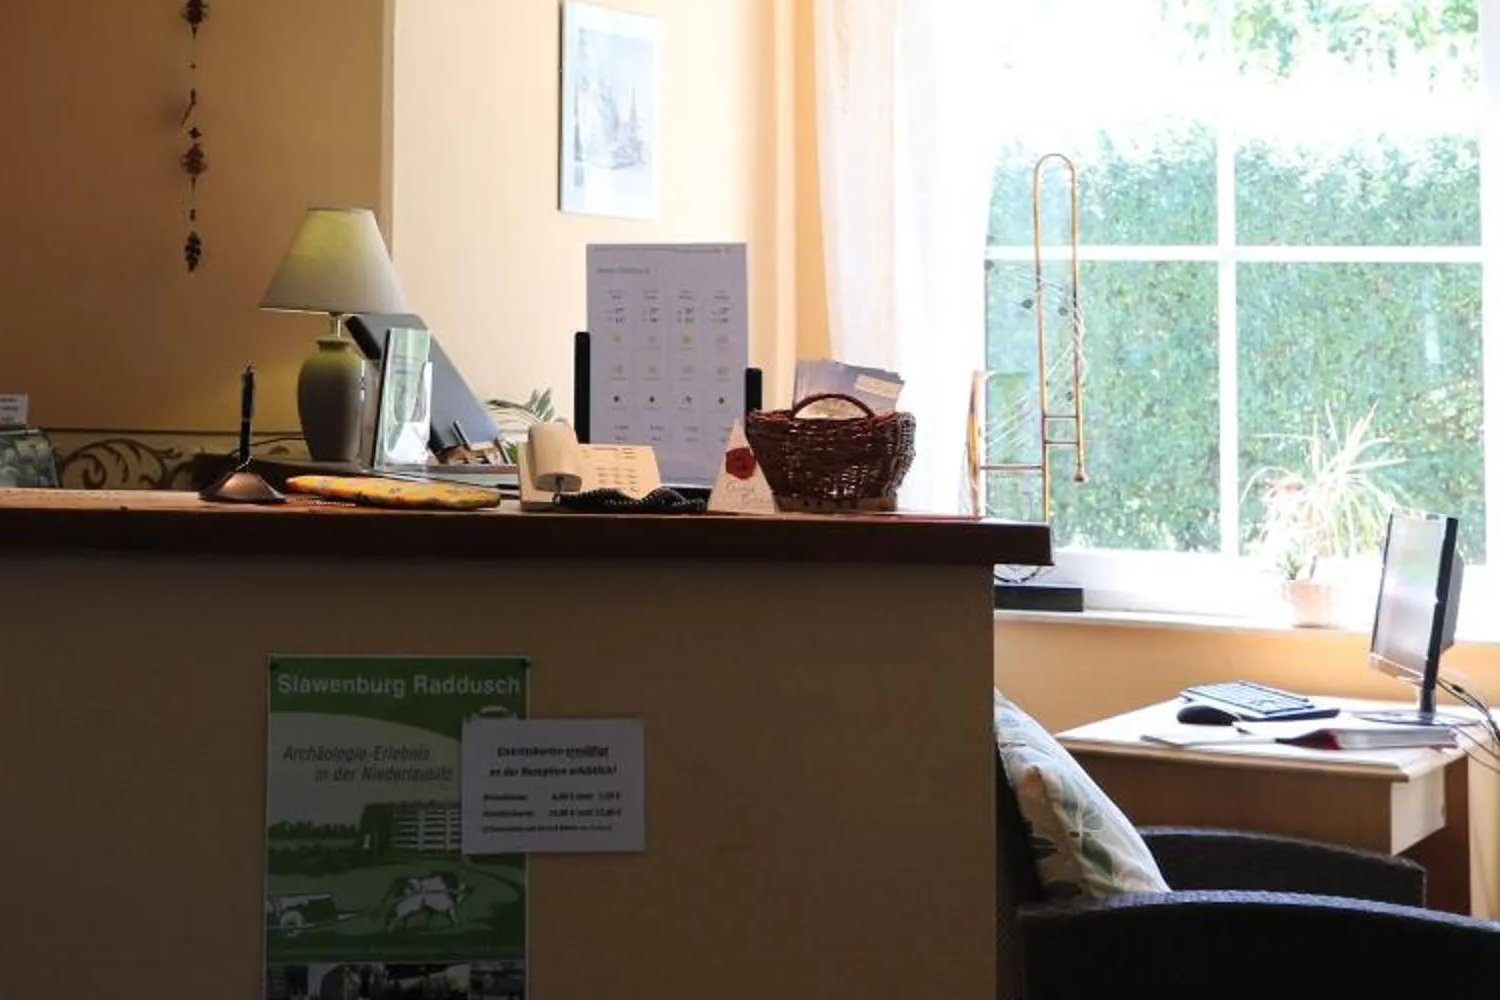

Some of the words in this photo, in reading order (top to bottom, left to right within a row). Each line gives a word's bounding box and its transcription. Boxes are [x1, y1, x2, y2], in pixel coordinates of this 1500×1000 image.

[277, 674, 405, 698] Slawenburg
[413, 674, 520, 695] Raddusch
[334, 766, 358, 782] der
